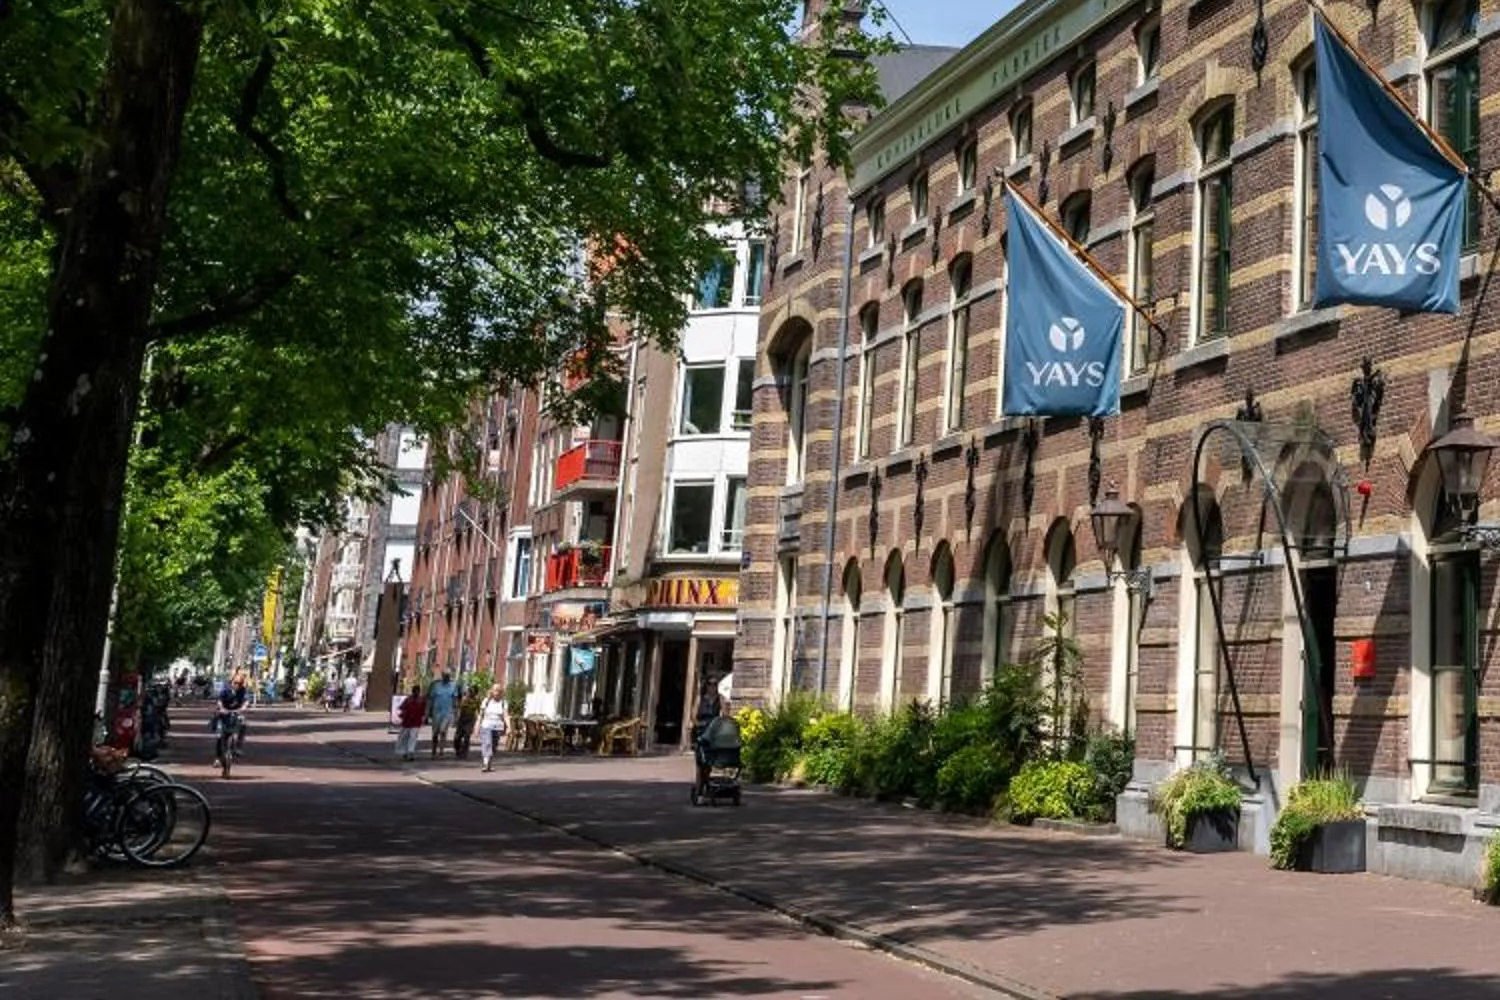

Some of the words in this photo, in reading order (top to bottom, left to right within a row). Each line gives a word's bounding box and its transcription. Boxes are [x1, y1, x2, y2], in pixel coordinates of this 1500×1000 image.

[992, 26, 1061, 87] FABRIEK
[1335, 242, 1440, 275] YAYS
[1025, 361, 1105, 386] YAYS
